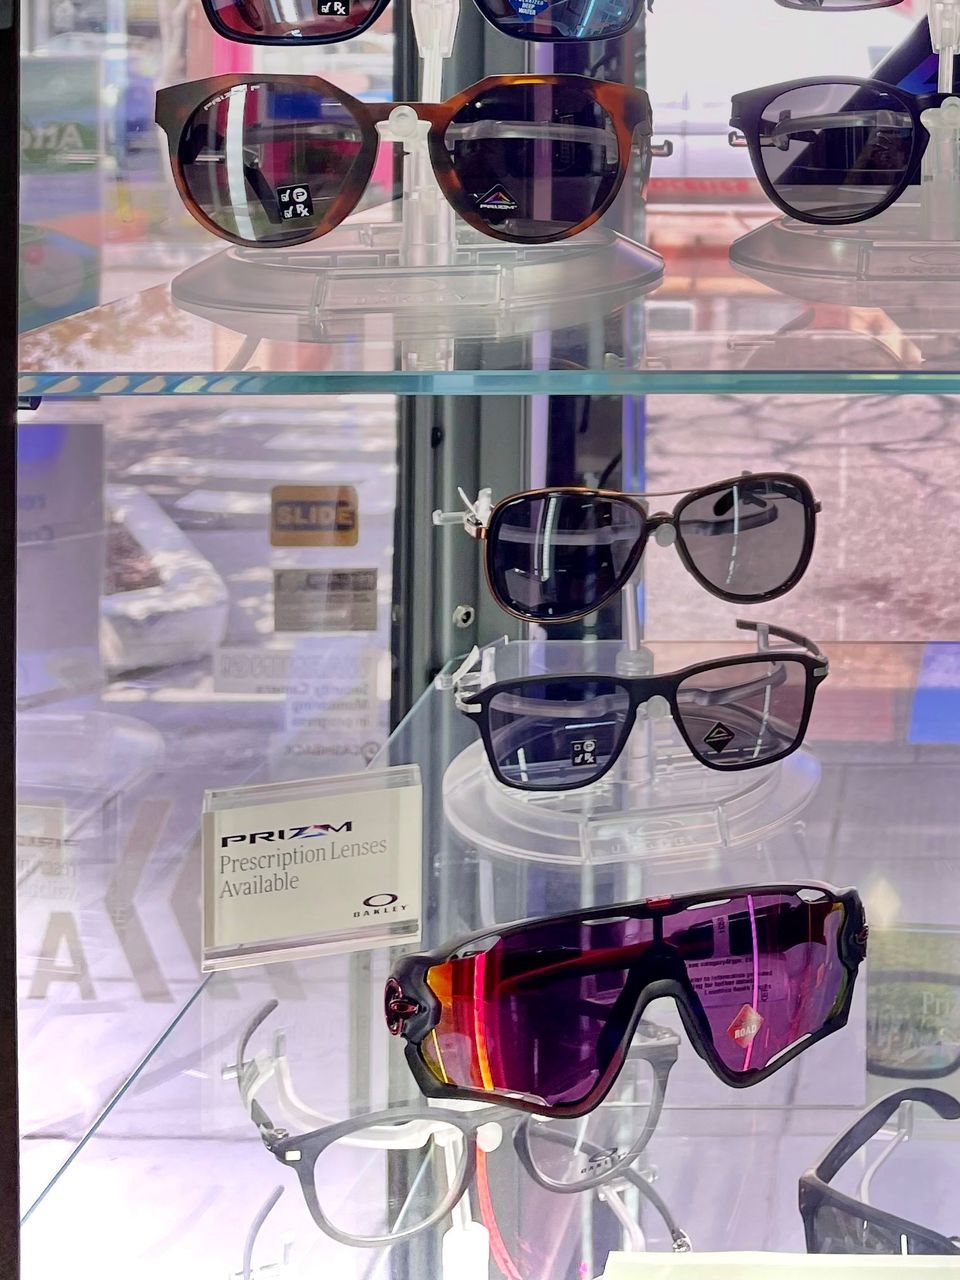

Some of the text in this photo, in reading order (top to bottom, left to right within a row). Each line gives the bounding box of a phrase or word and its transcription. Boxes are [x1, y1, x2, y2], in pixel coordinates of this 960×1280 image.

[220, 821, 353, 848] PRIZM
[220, 839, 388, 875] Prescription Lenses
[219, 872, 300, 899] Available
[353, 905, 409, 918] OAKLEY
